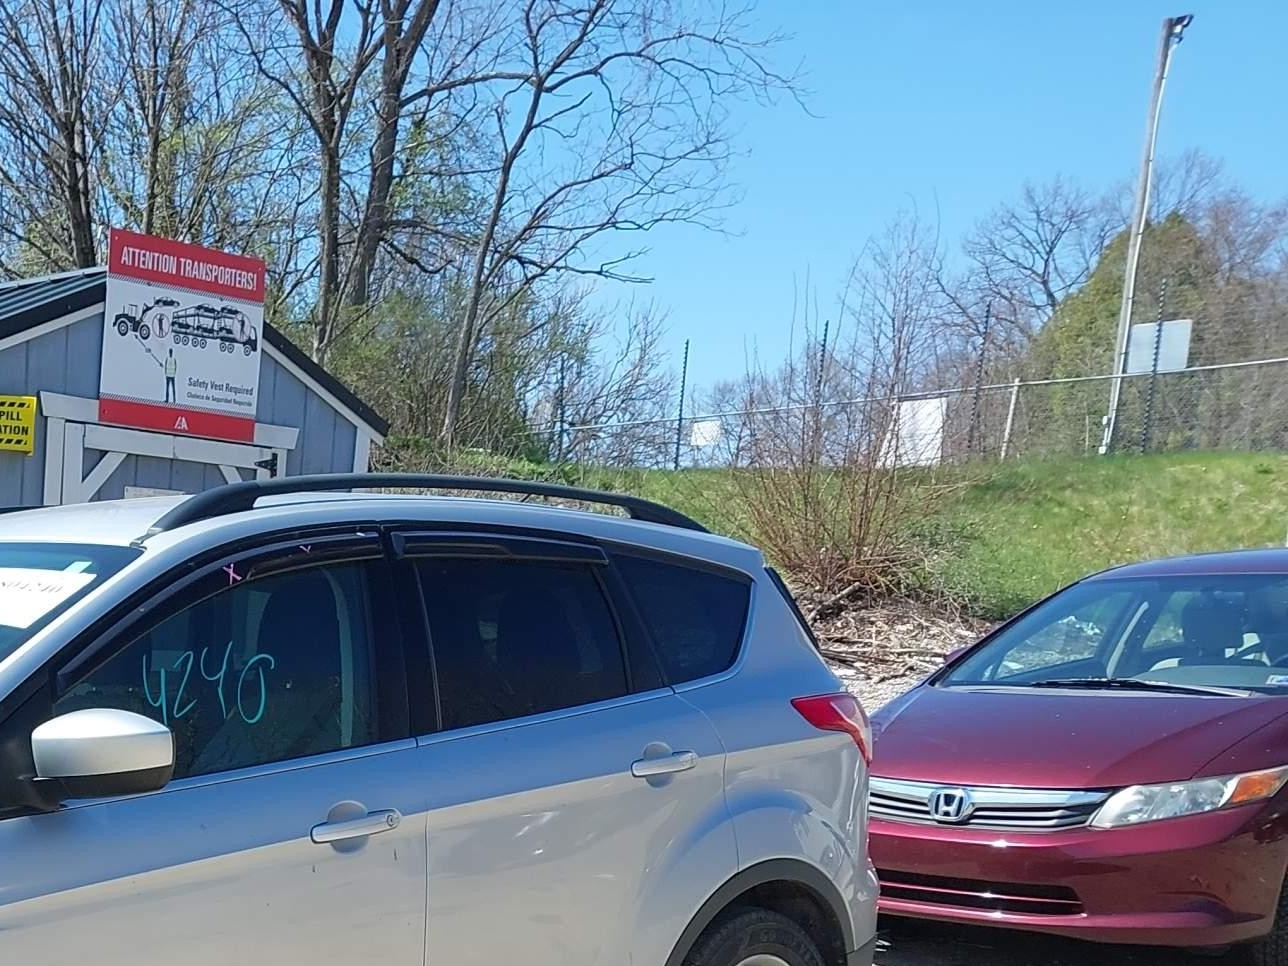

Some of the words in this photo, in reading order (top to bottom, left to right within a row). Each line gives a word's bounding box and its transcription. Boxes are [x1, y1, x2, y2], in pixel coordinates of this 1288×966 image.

[121, 246, 177, 275] ATTENTION
[179, 257, 257, 291] TRANSPORTERS!
[188, 377, 208, 391] Safety
[210, 380, 224, 391] Vest
[143, 641, 274, 725] 4240
